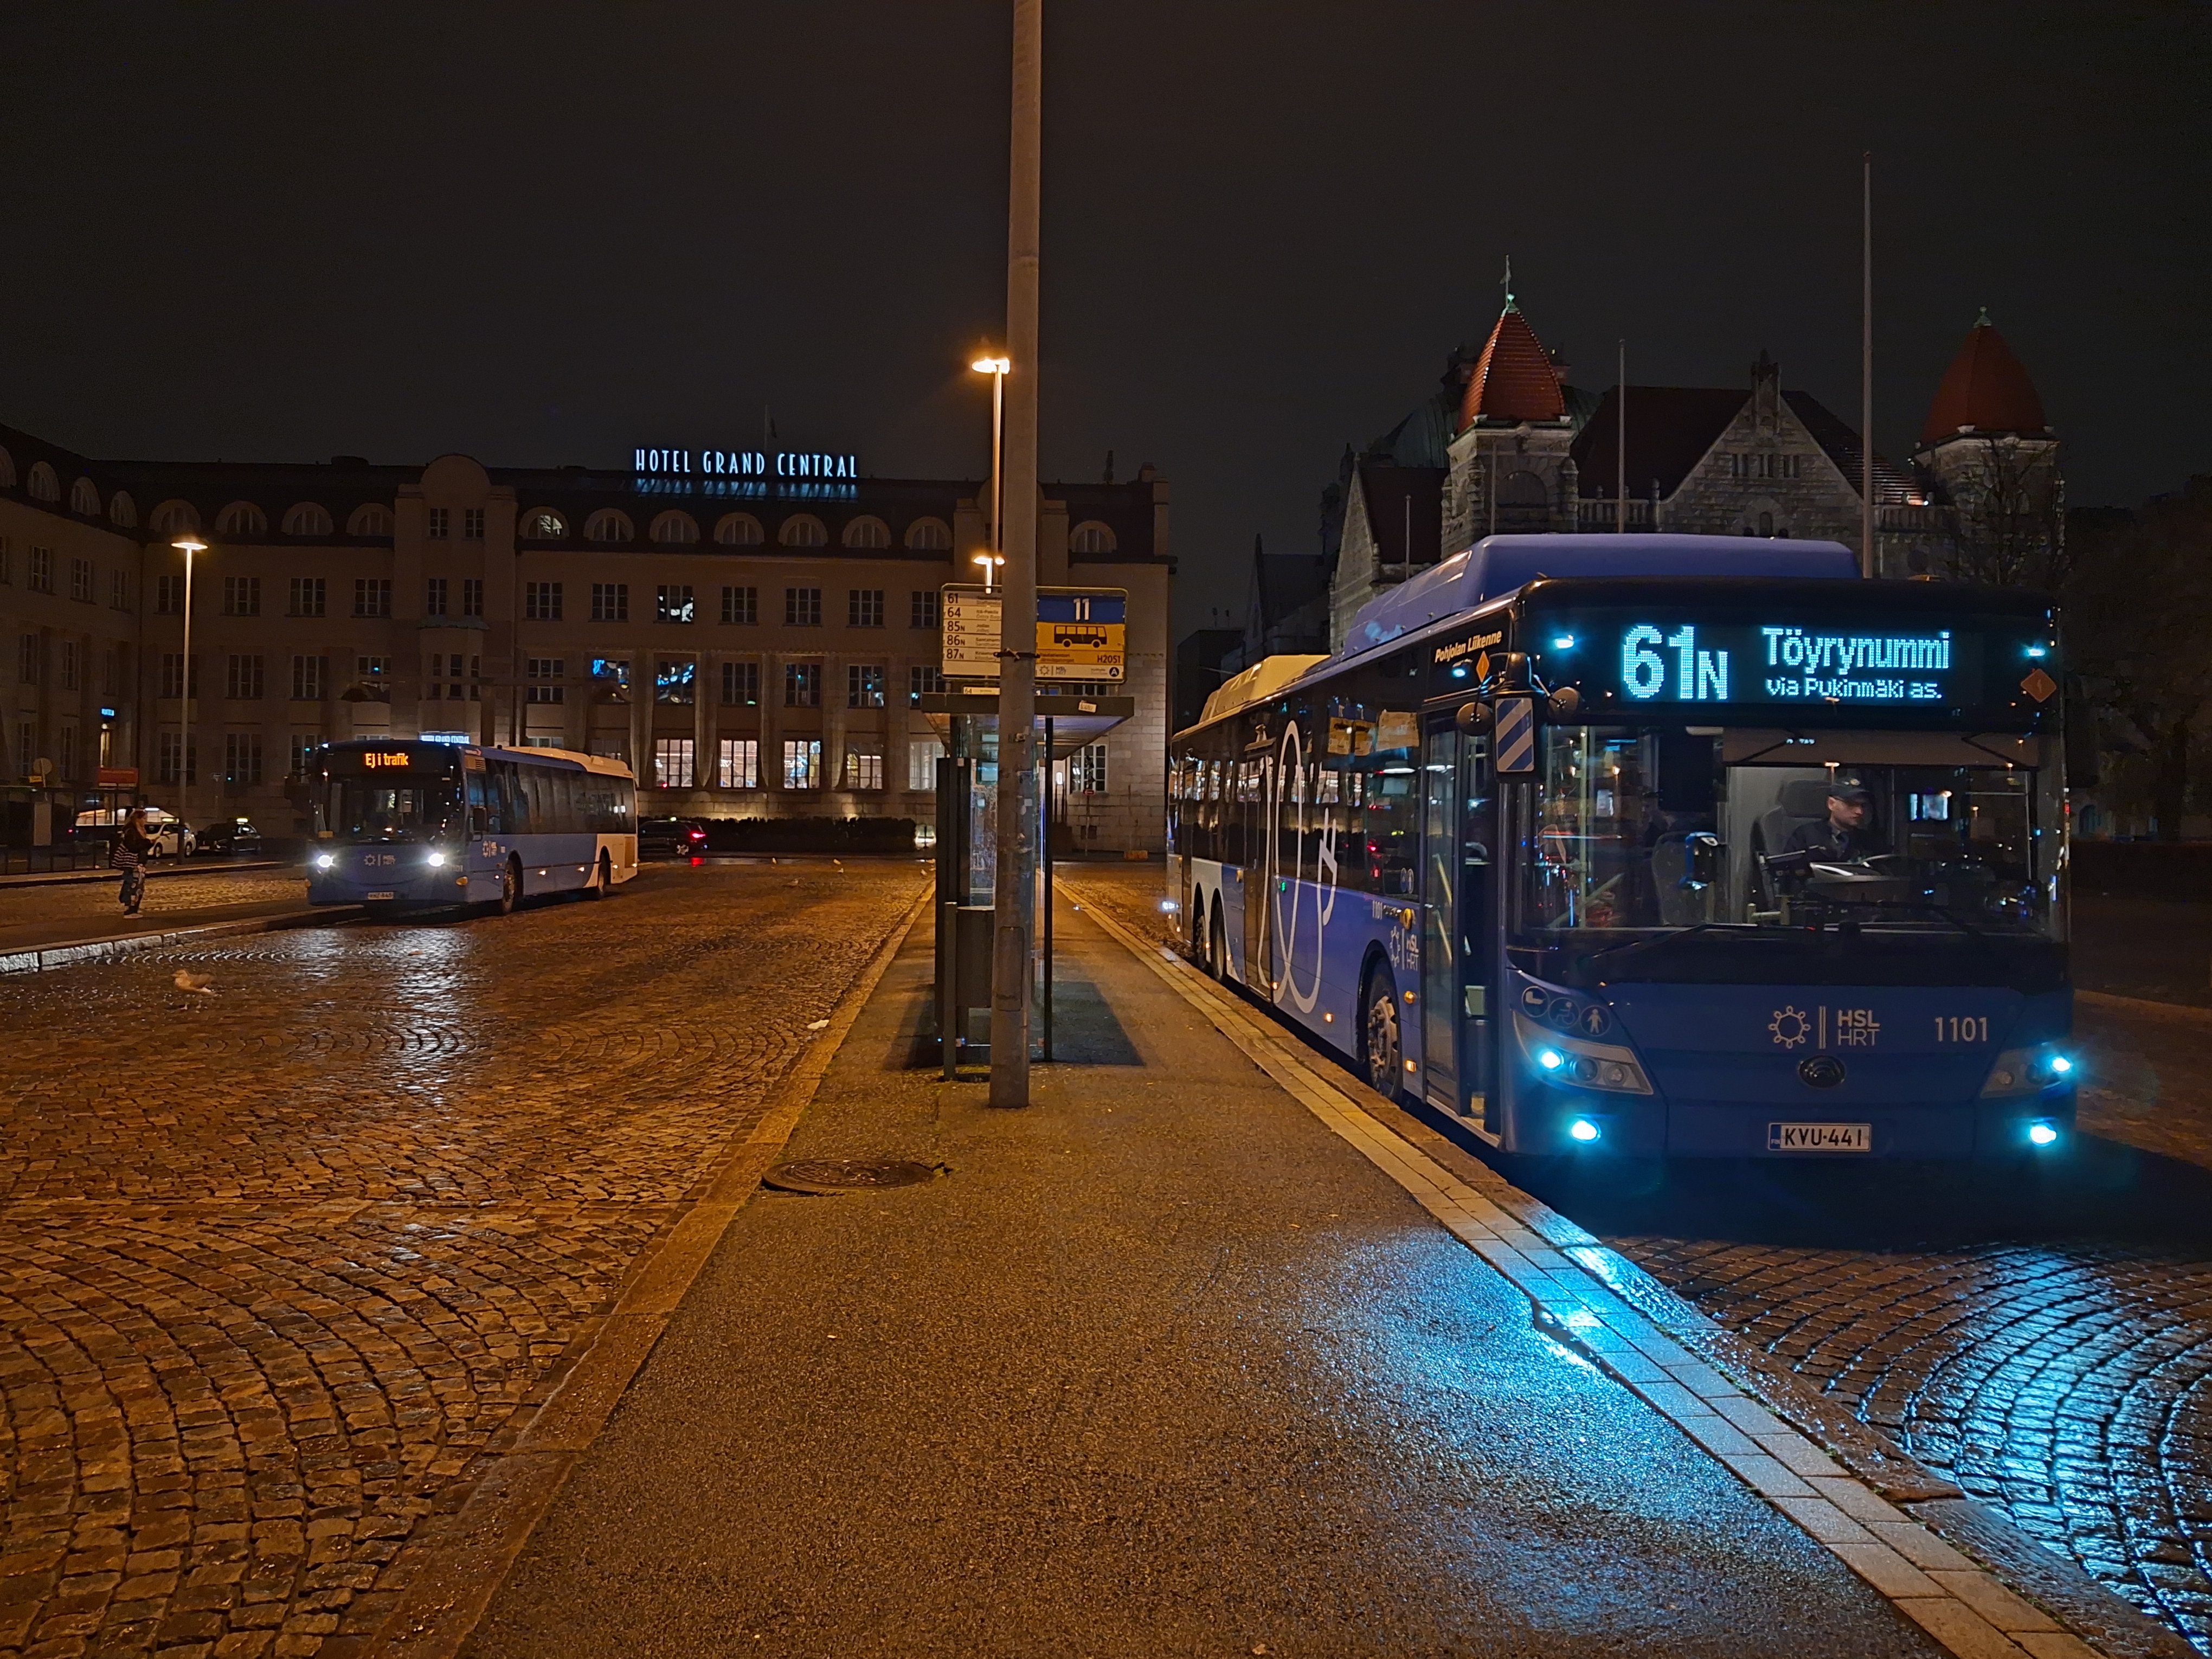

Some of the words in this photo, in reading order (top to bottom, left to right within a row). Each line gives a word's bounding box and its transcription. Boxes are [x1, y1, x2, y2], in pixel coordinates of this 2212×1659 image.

[635, 449, 691, 473] HOTEL
[703, 451, 765, 474] GRAND
[777, 453, 857, 478] CENTRAL
[948, 593, 959, 604] 61
[947, 607, 961, 618] 64
[1073, 597, 1090, 621] 11
[947, 621, 965, 632] 85N
[947, 634, 965, 646] 86N
[1435, 642, 1466, 663] Pohjolan
[1467, 631, 1502, 653] Liikenne
[946, 648, 964, 659] 87N
[1097, 654, 1121, 664] H2051
[1763, 627, 1950, 675] Töyrynummi
[1624, 625, 1728, 699] 61N
[1766, 677, 1799, 696] via
[1804, 678, 1904, 698] Pukinmäki
[1909, 682, 1943, 699] as.
[365, 753, 375, 768] Ej
[377, 753, 382, 766] i
[383, 753, 409, 766] trafik
[1837, 1009, 1880, 1027] HSL
[1837, 1028, 1880, 1046] HRT
[1935, 1017, 1988, 1041] 1101
[1785, 1128, 1862, 1147] KVU-441
